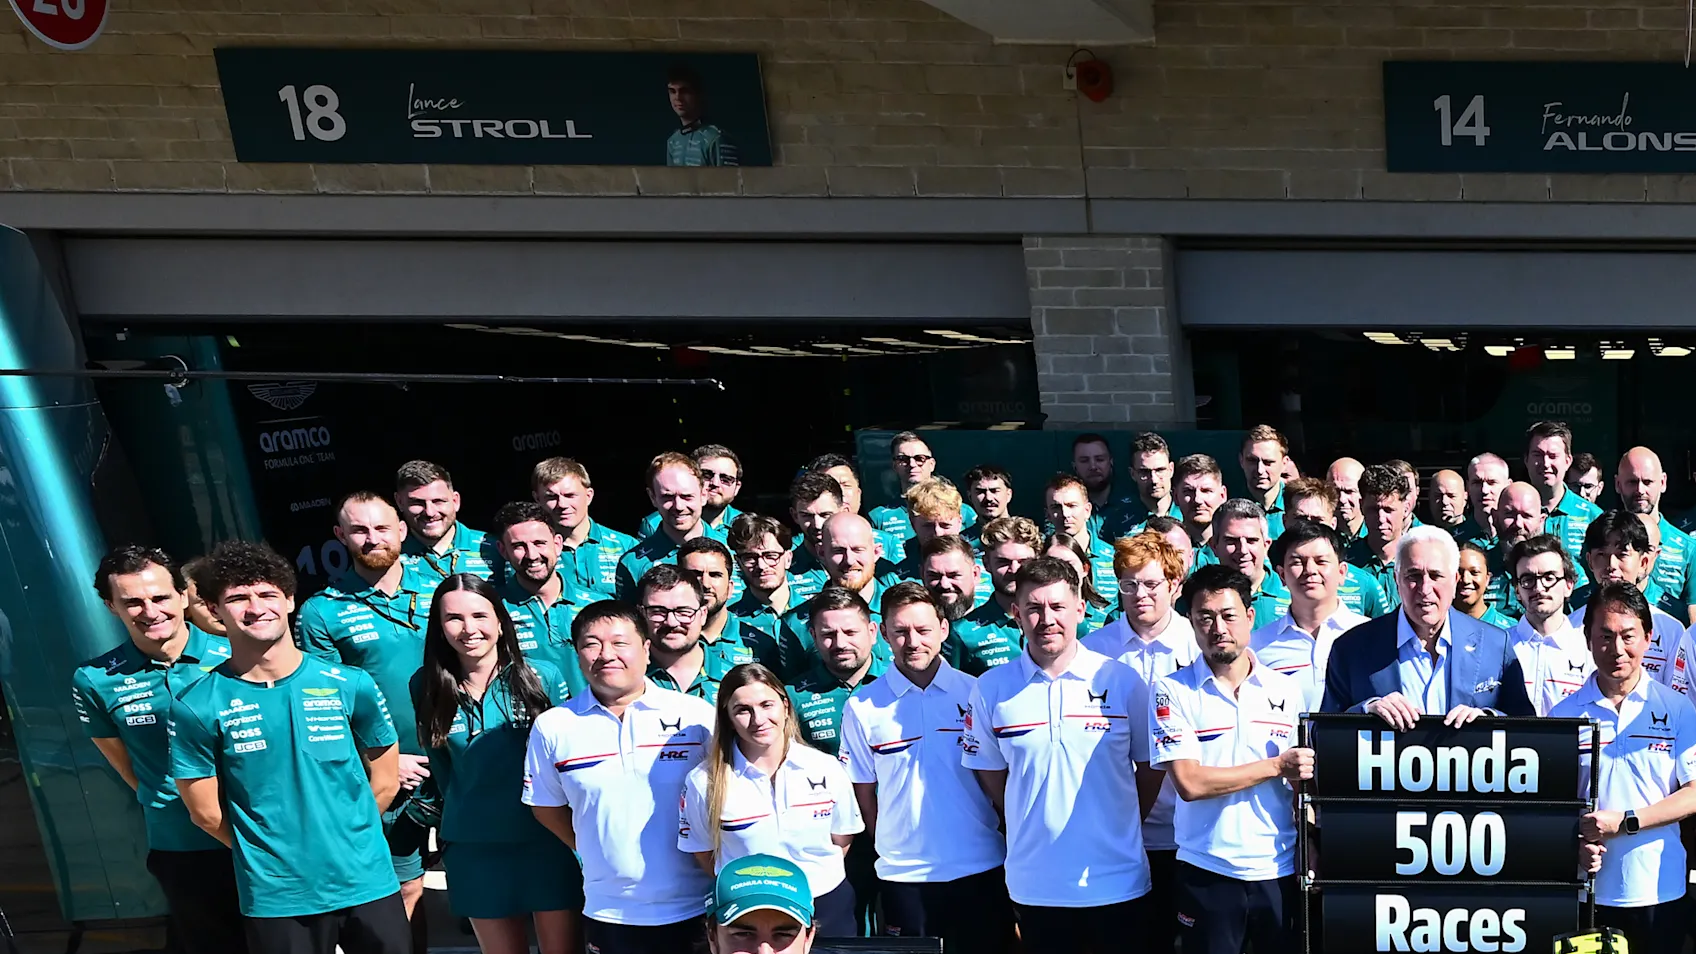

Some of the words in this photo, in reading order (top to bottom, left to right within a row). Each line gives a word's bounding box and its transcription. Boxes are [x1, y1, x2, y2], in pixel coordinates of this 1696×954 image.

[407, 83, 466, 120] Lance
[279, 84, 347, 142] 18
[1541, 91, 1634, 135] Fernando
[1433, 95, 1491, 146] 14
[413, 119, 593, 139] STROLL
[259, 425, 331, 453] aramco
[349, 622, 374, 633] BOSS
[987, 657, 1009, 666] BOSS
[124, 702, 152, 713] BOSS
[801, 698, 834, 709] MAADEN
[803, 707, 836, 718] cognizant
[127, 716, 155, 726] JCB
[809, 718, 833, 728] BOSS
[1084, 722, 1112, 731] HRC
[231, 727, 262, 739] BOSS
[235, 741, 266, 752] JCB
[1648, 743, 1671, 752] HRC
[659, 750, 688, 758] HRC
[1357, 730, 1539, 794] Honda
[1395, 811, 1507, 876] 500
[730, 880, 763, 892] FORMULA
[764, 879, 778, 888] ONE
[780, 882, 798, 893] TEAM
[1375, 894, 1527, 953] Races
